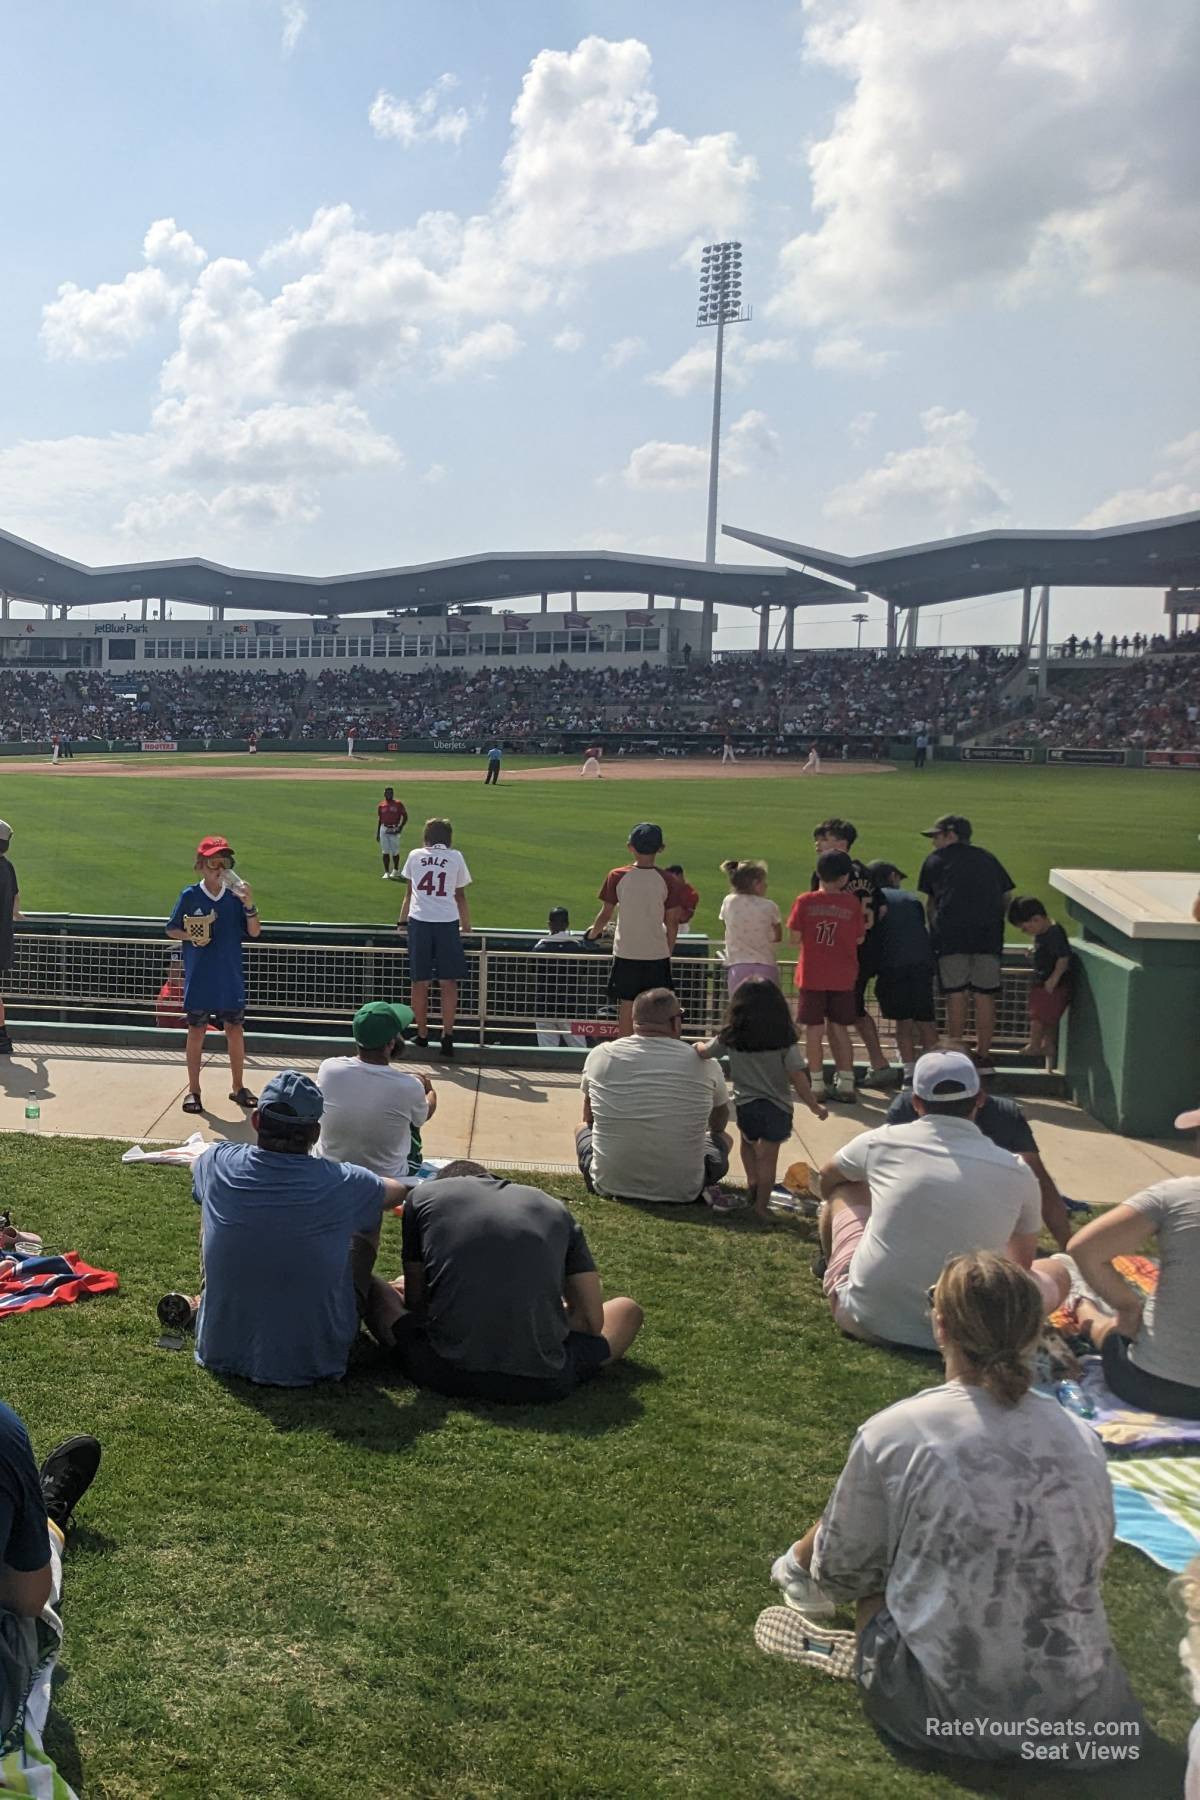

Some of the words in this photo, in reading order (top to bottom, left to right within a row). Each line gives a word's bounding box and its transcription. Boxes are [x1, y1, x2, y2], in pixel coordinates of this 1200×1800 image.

[94, 623, 125, 635] jetBlue
[126, 623, 149, 633] Park
[420, 856, 449, 869] SALE
[417, 870, 448, 897] 41
[577, 1024, 595, 1034] NO
